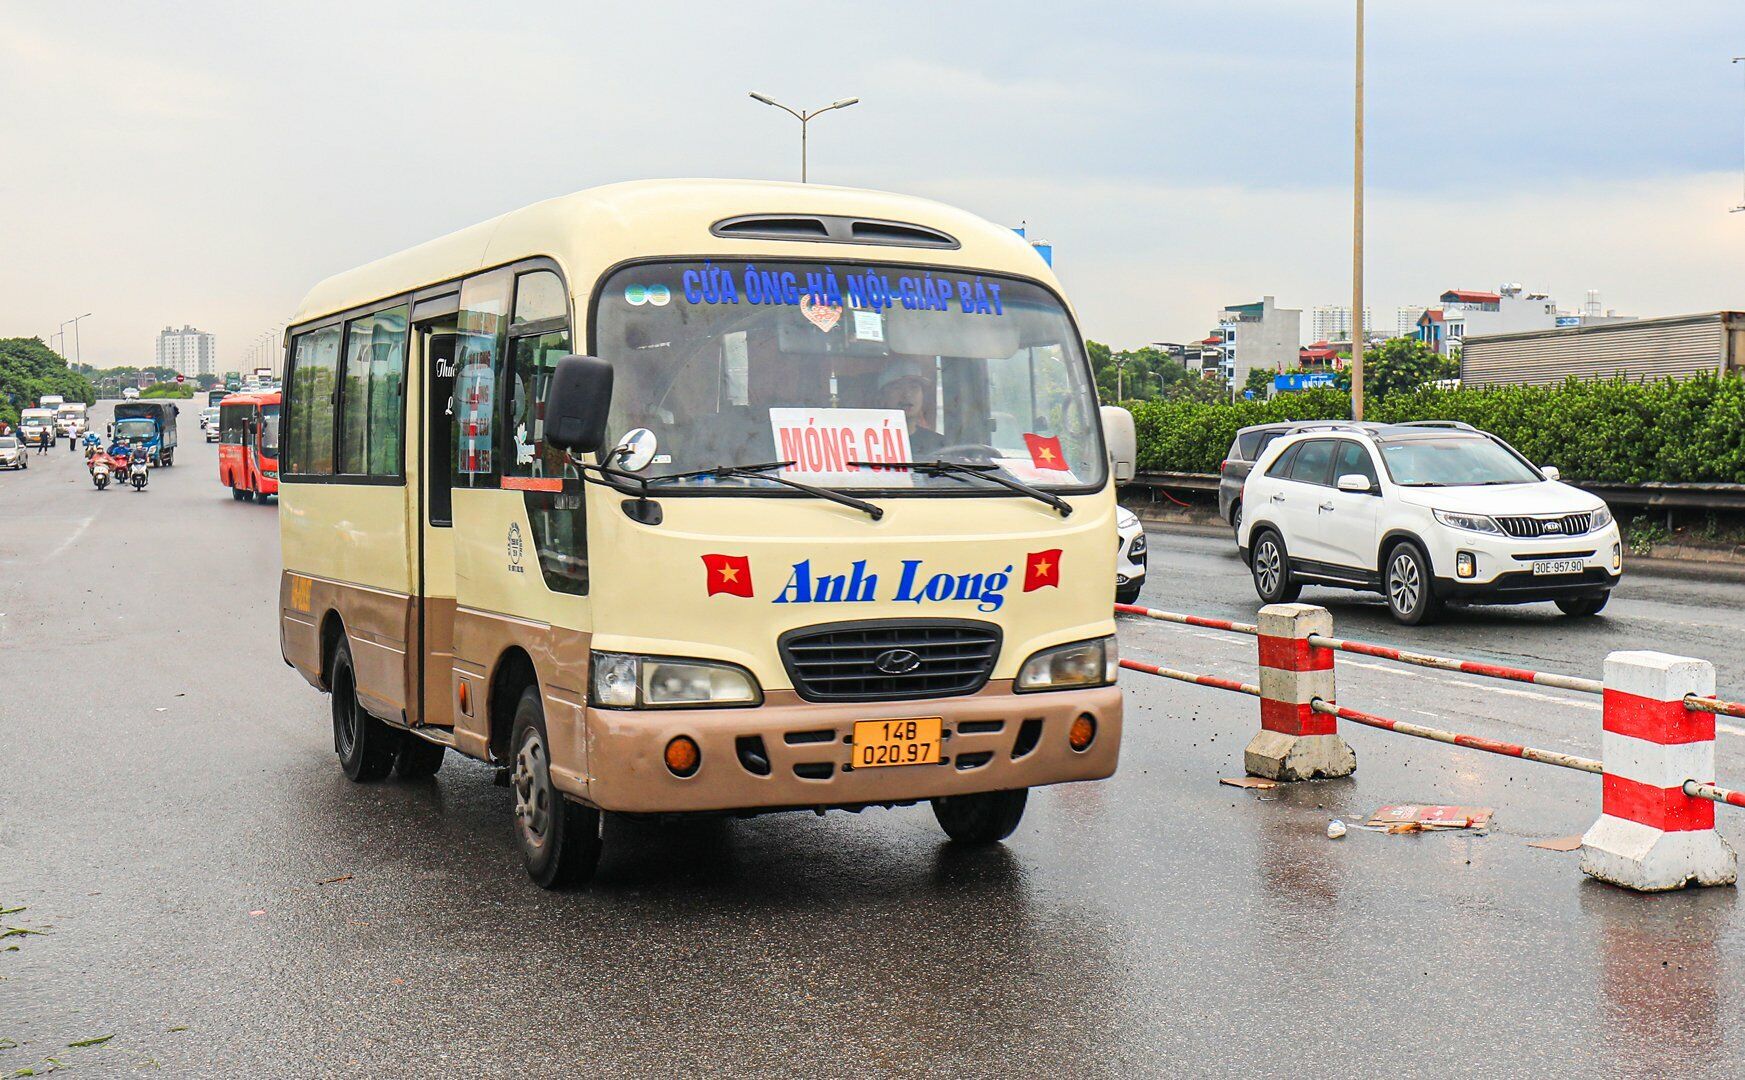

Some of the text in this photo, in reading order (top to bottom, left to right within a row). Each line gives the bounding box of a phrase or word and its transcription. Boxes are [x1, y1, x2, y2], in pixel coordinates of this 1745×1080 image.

[957, 275, 1003, 316] BÁT
[779, 417, 908, 473] MÓNG CÁI
[1535, 560, 1582, 574] 30E-957.90
[771, 559, 1013, 612] Anh Long
[883, 721, 917, 741] 14B
[863, 743, 931, 764] 020.97
